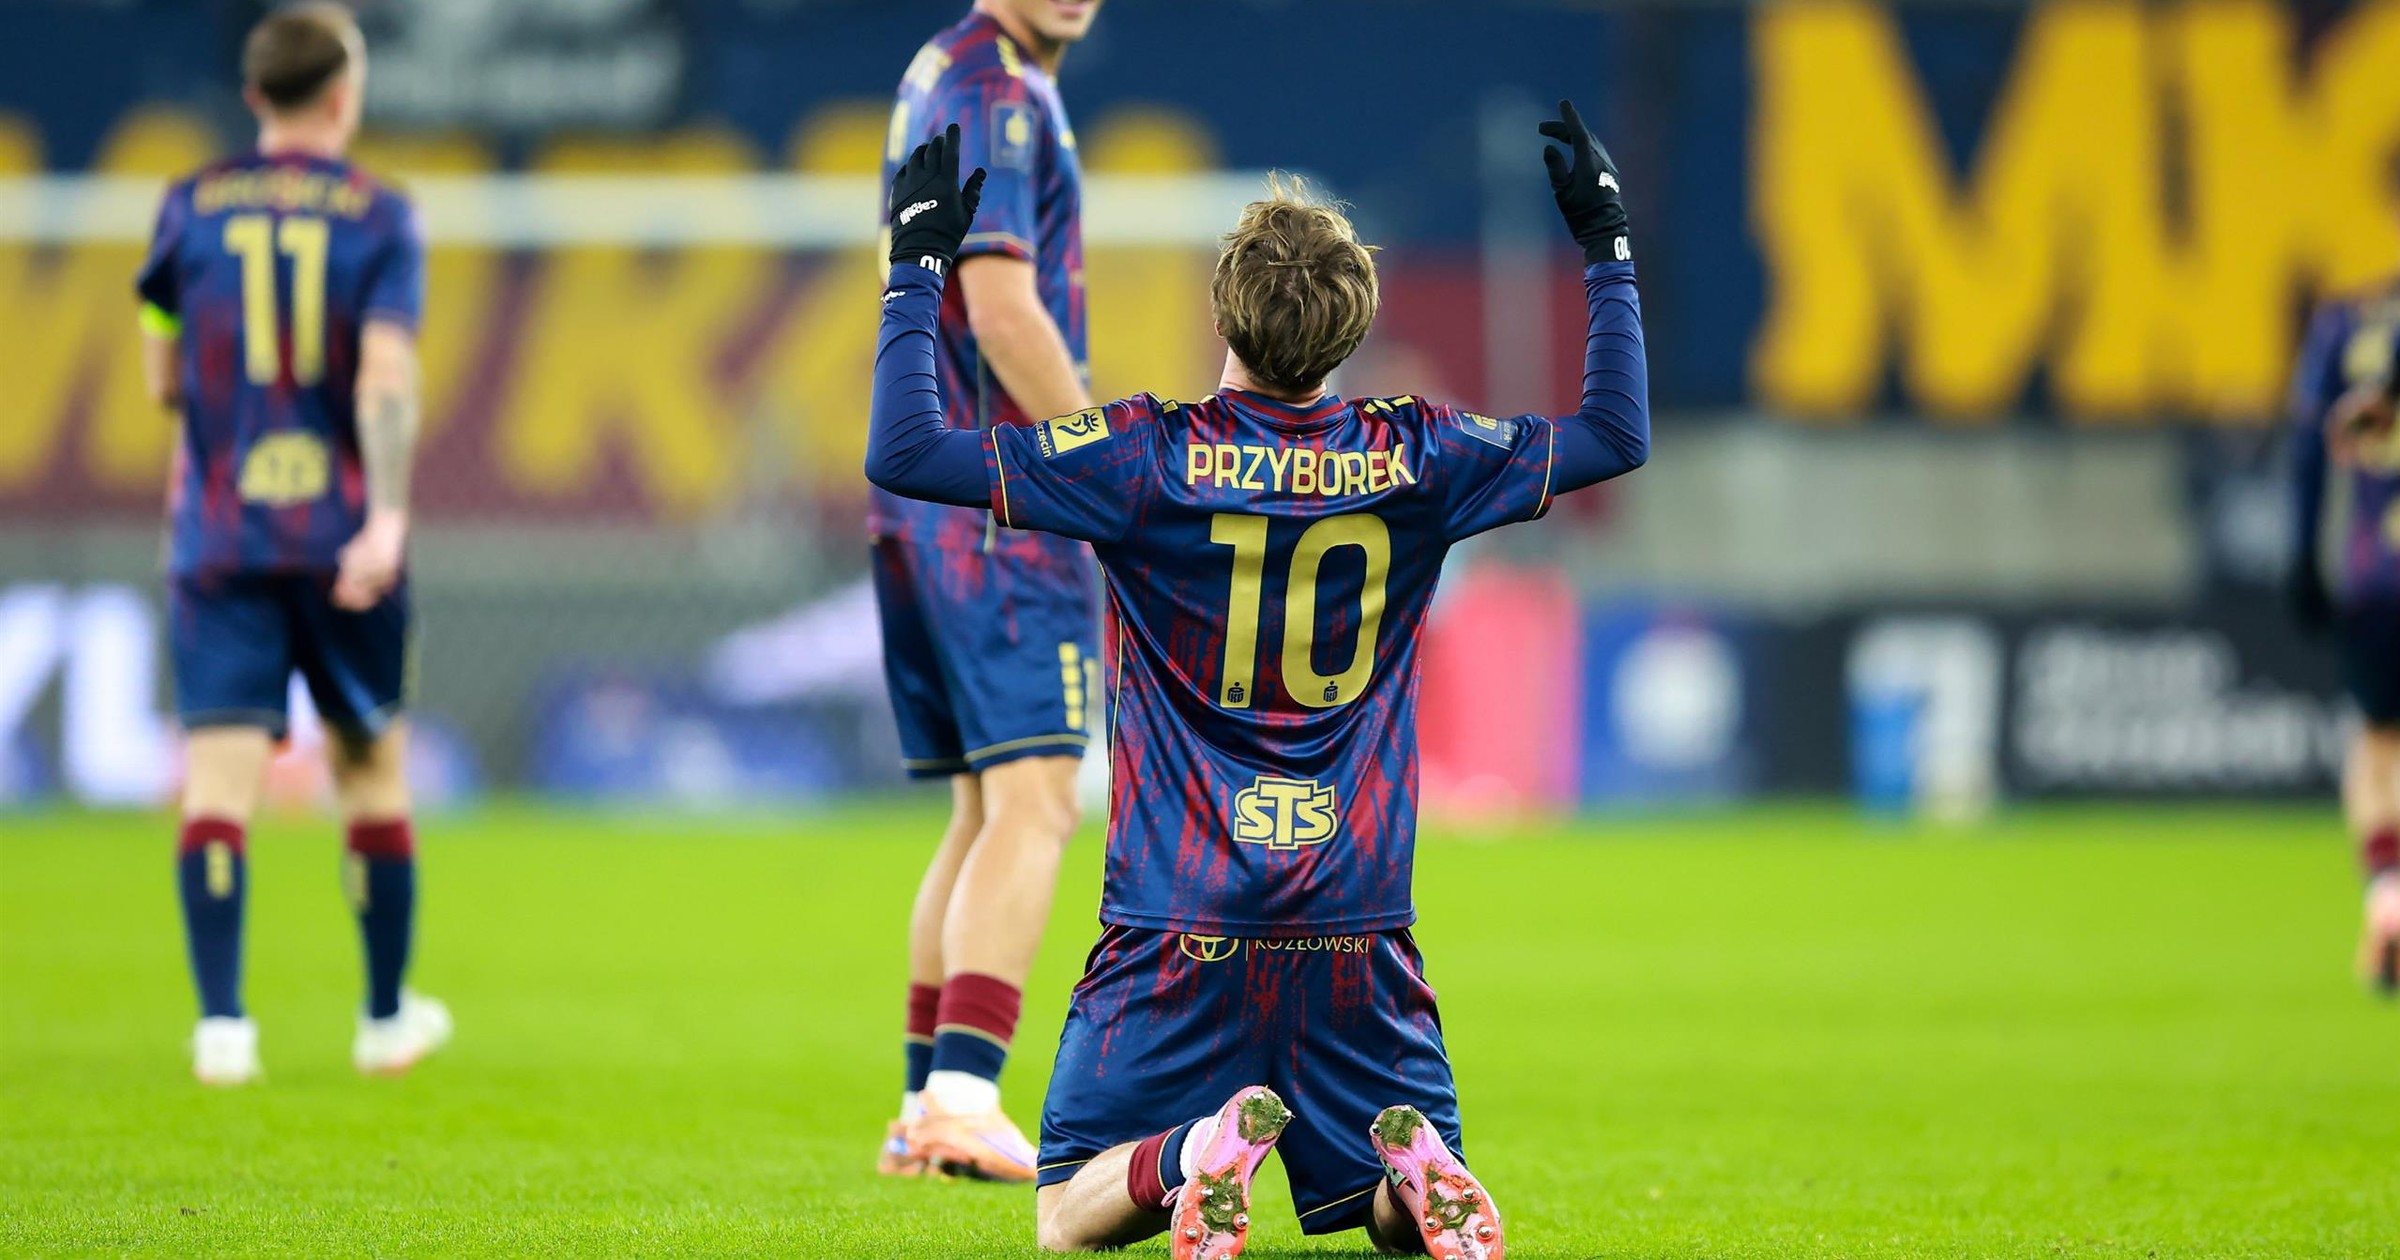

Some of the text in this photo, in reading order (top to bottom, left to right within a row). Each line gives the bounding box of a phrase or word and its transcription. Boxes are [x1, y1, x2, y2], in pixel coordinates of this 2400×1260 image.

[223, 212, 328, 386] 11
[1187, 443, 1417, 496] PRZYBOREK
[1210, 512, 1391, 708] 10
[1233, 775, 1337, 850] STS
